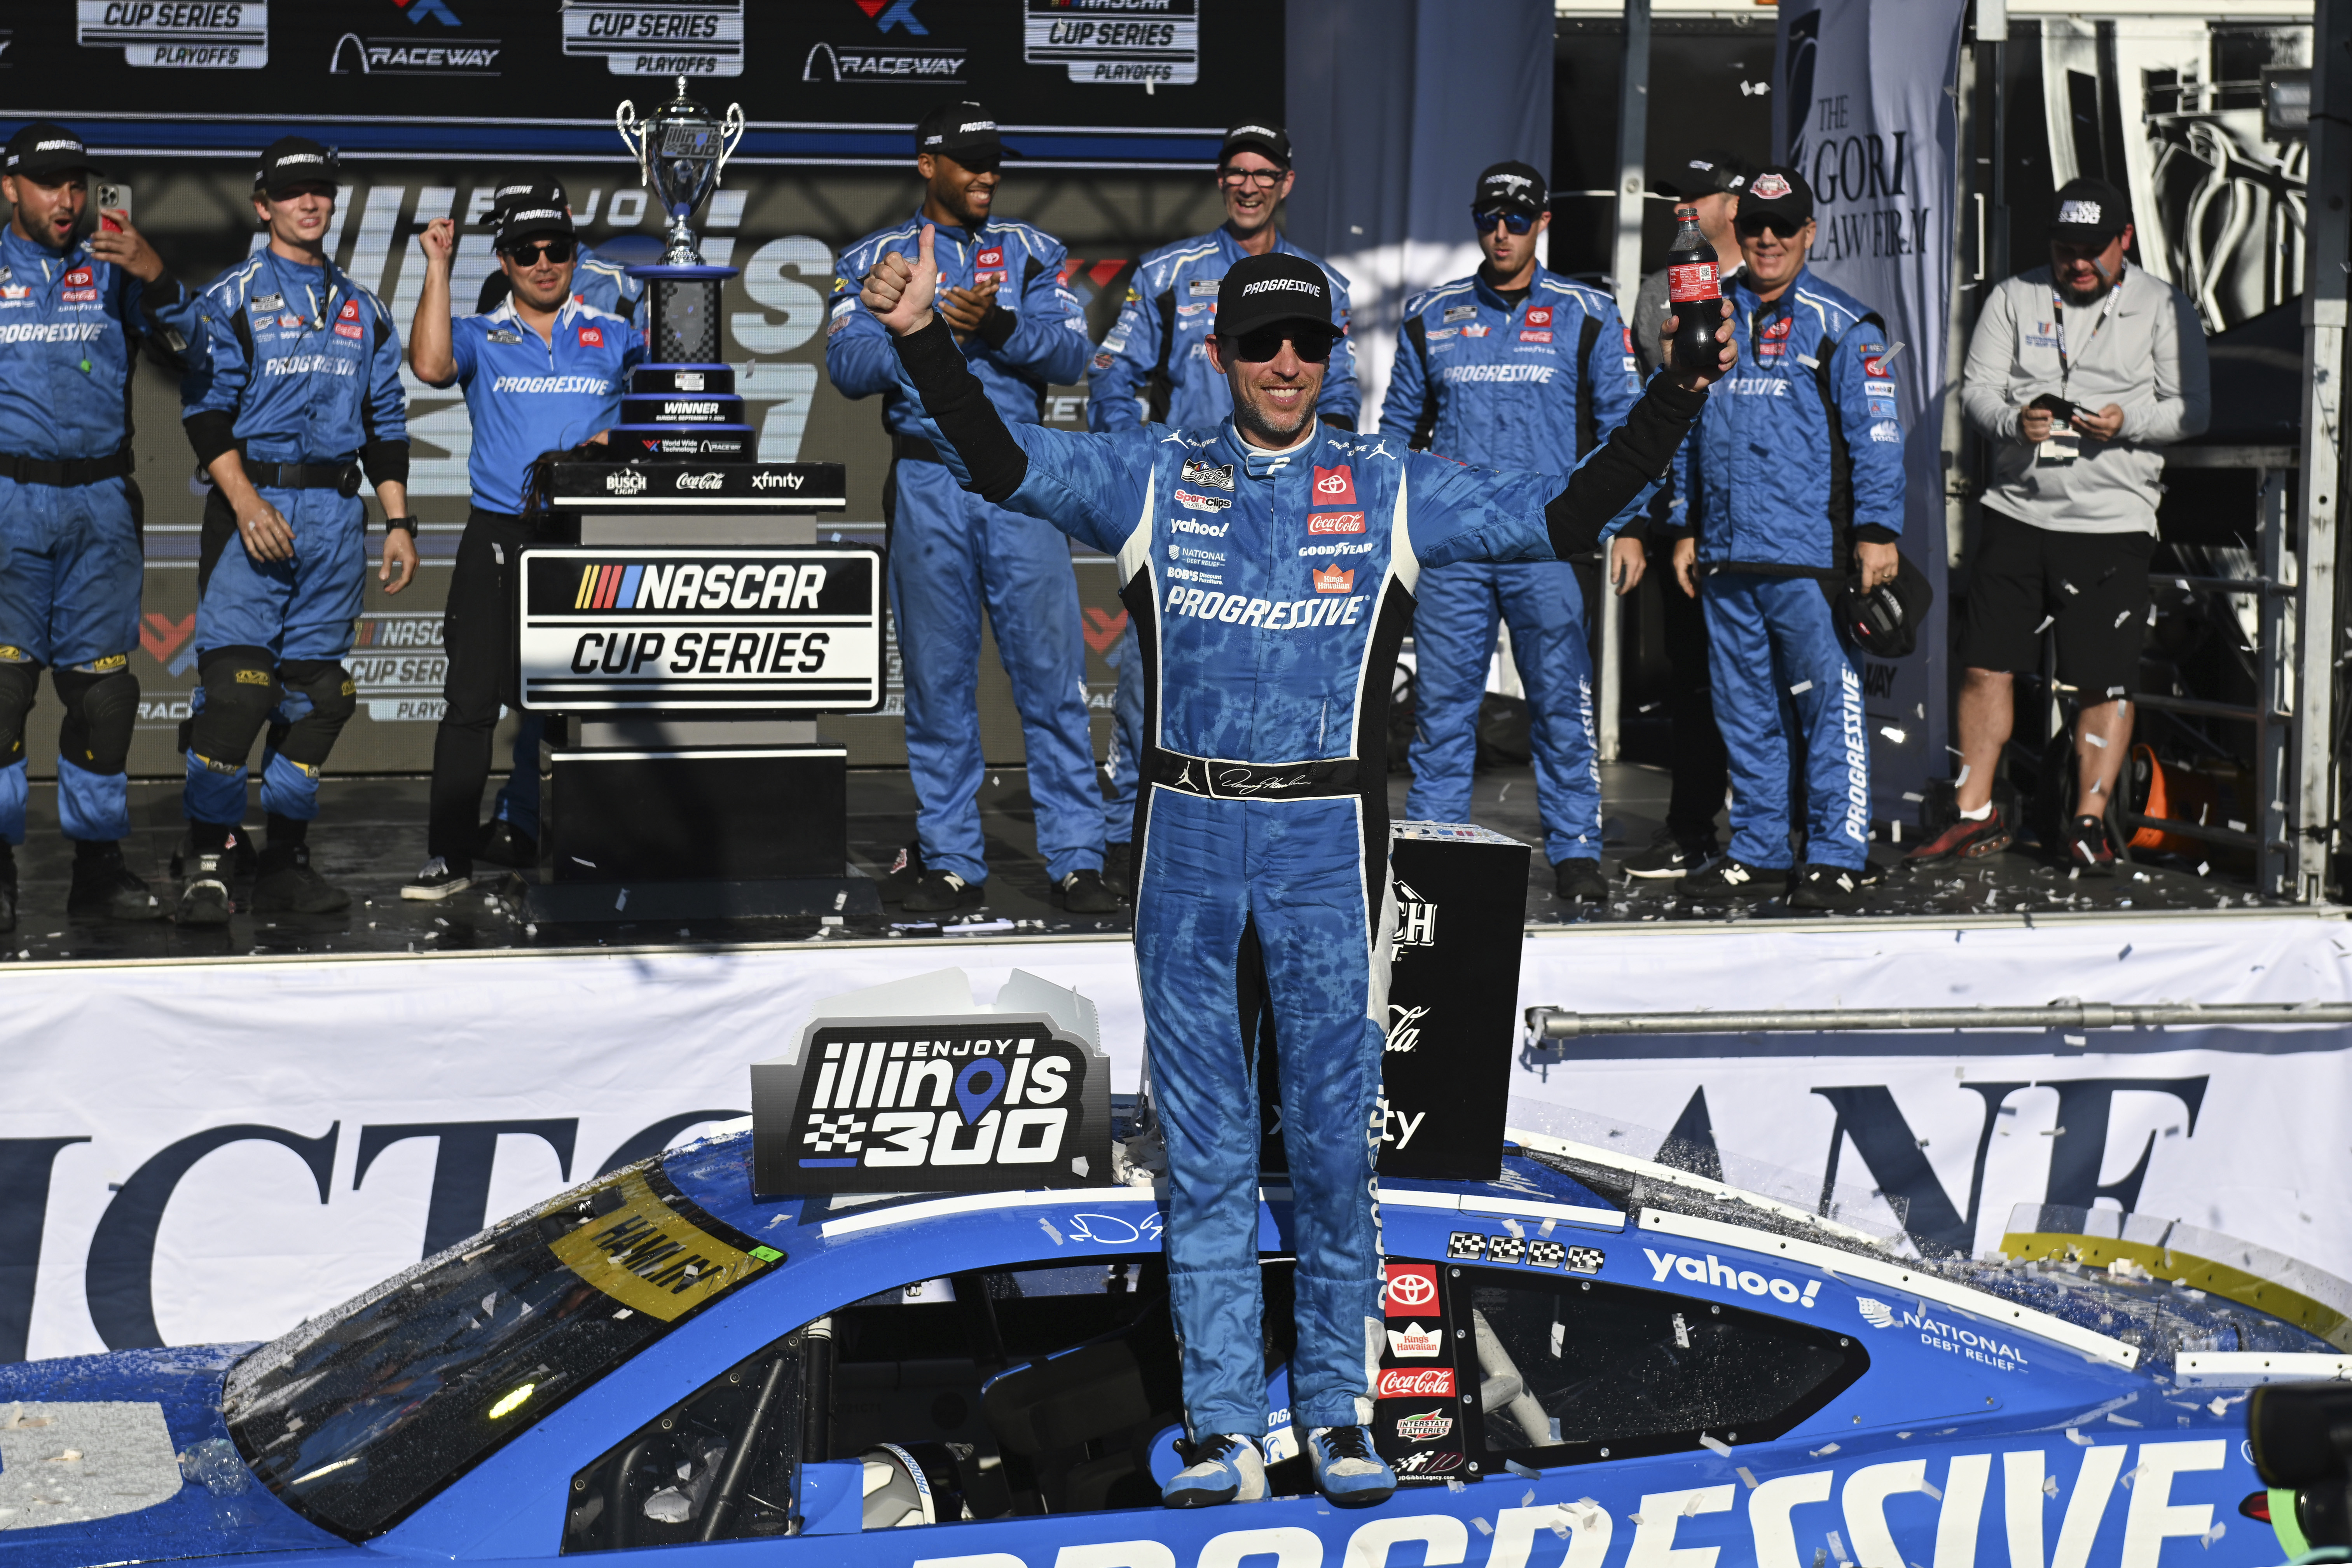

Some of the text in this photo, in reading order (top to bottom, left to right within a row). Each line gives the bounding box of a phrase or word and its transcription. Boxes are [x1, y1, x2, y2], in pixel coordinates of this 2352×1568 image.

[105, 4, 241, 28] CUP SERIES
[588, 14, 718, 37] CUP SERIES
[1050, 22, 1174, 46] CUP SERIES
[156, 47, 238, 64] PLAYOFFS
[369, 47, 499, 66] RACEWAY
[636, 56, 716, 72] PLAYOFFS
[840, 56, 965, 74] RACEWAY
[1095, 64, 1172, 81] PLAYOFFS
[1818, 95, 1849, 132] THE
[36, 140, 83, 152] PROGRESSIVE
[276, 154, 324, 168] PROGRESSIVE
[1814, 131, 1907, 206] GORI
[513, 209, 562, 223] PROGRESSIVE
[1808, 207, 1931, 262] LAW FIRM
[1243, 279, 1321, 297] PROGRESSIVE
[265, 354, 357, 377] PROGRESSIV
[1444, 364, 1554, 384] PROGRESSIVE
[493, 376, 609, 395] PROGRESSIVE
[664, 402, 719, 414] WINNER
[1266, 457, 1290, 475] P
[606, 474, 647, 490] BUSCH
[676, 472, 725, 490] Coca-Cola
[752, 471, 804, 490] xfinity
[1190, 470, 1230, 486] CUP SERIES
[1186, 503, 1217, 512] HAIRCUTS
[1171, 518, 1229, 537] yahoo!
[1310, 514, 1362, 533] Coca-Cola
[1182, 548, 1226, 561] NATIONAL
[1299, 542, 1372, 557] GOODYEAR
[1167, 567, 1199, 581] BOB'S
[636, 565, 827, 609] NASCAR
[1165, 585, 1364, 630] PROGRESSIVE
[382, 620, 445, 646] NASC
[571, 633, 830, 675] CUP SERIES
[351, 660, 446, 683] CUP SER
[397, 701, 449, 719] PLAYO
[1842, 668, 1867, 843] PROGRESSIVE
[912, 1039, 1014, 1057] ENJOY
[812, 1038, 1071, 1109] illinois
[864, 1108, 1068, 1167] 300
[0, 1110, 752, 1361] ICT
[590, 1215, 724, 1294] HAMLIN
[1643, 1248, 1822, 1308] yahoo!
[1404, 1335, 1429, 1343] King's
[1903, 1311, 2029, 1365] NATIONAL
[1921, 1333, 2015, 1372] DEBT RELIEF
[1380, 1370, 1452, 1395] Coca-Cola
[911, 1439, 2226, 1568] ESSIVE
